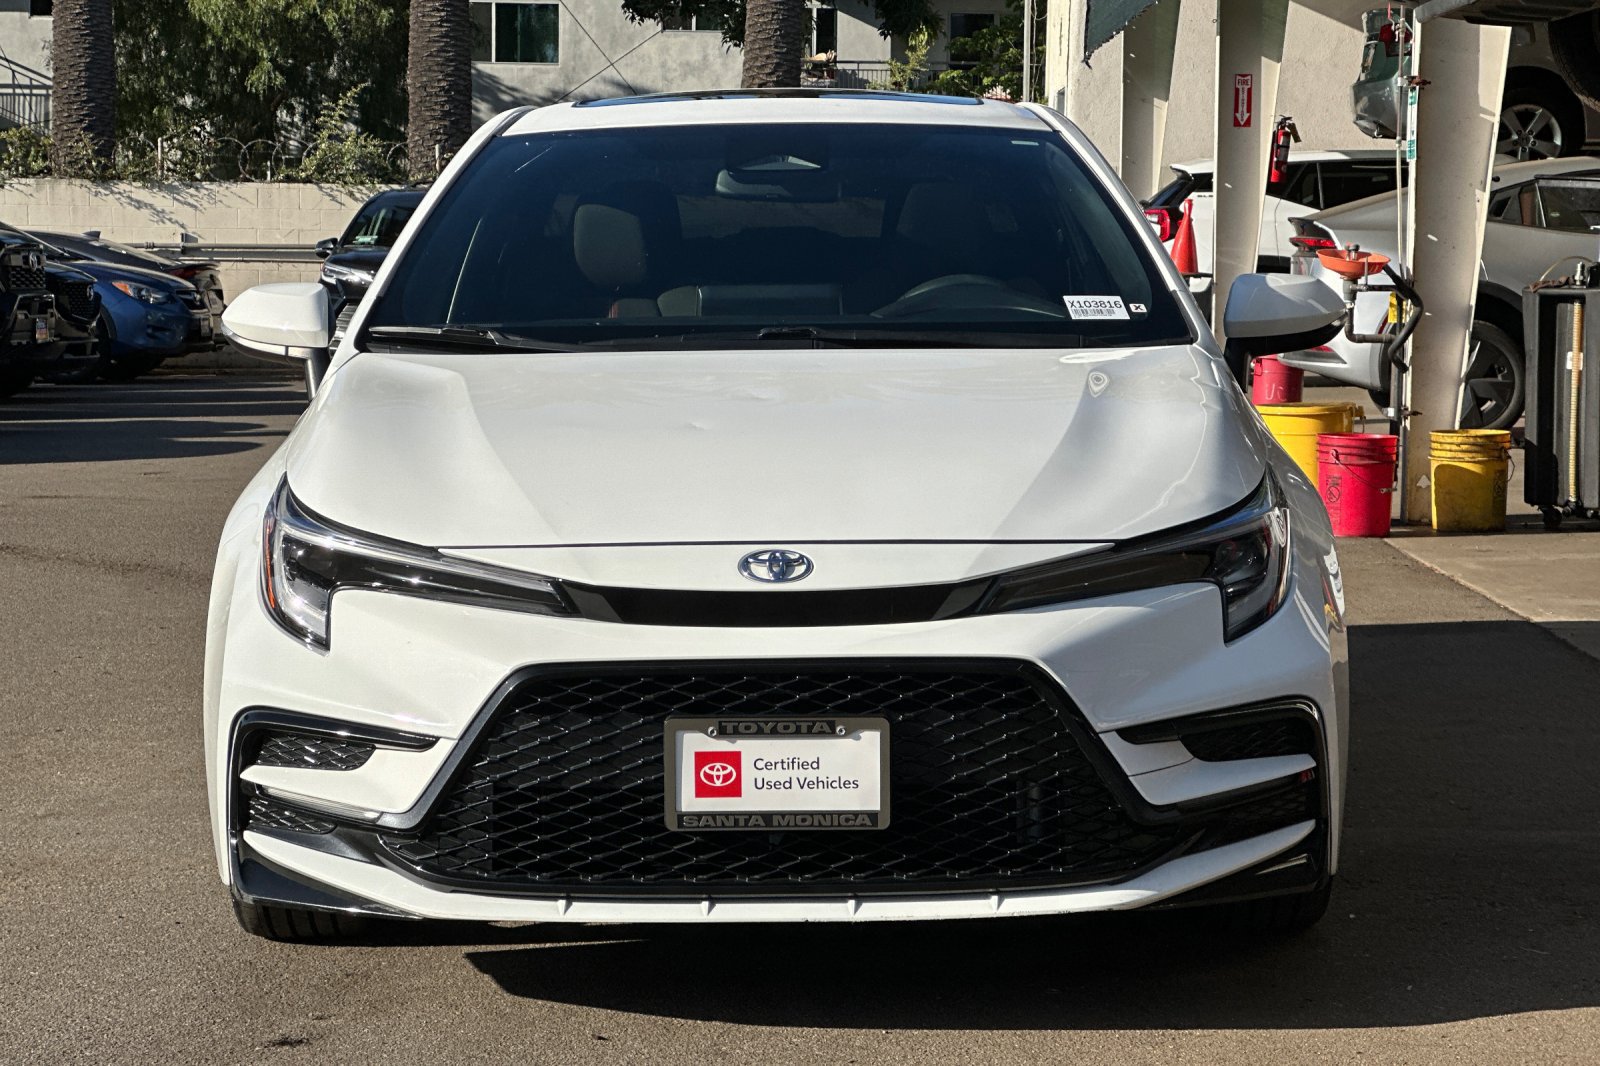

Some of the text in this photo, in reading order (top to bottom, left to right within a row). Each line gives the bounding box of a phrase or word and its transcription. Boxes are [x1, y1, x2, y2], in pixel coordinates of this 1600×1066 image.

[1068, 300, 1122, 309] X103816
[722, 722, 832, 734] TOYOTA
[753, 757, 820, 771] Certified
[754, 776, 859, 790] Used Vehicles
[683, 814, 872, 827] SANTA MONICA
